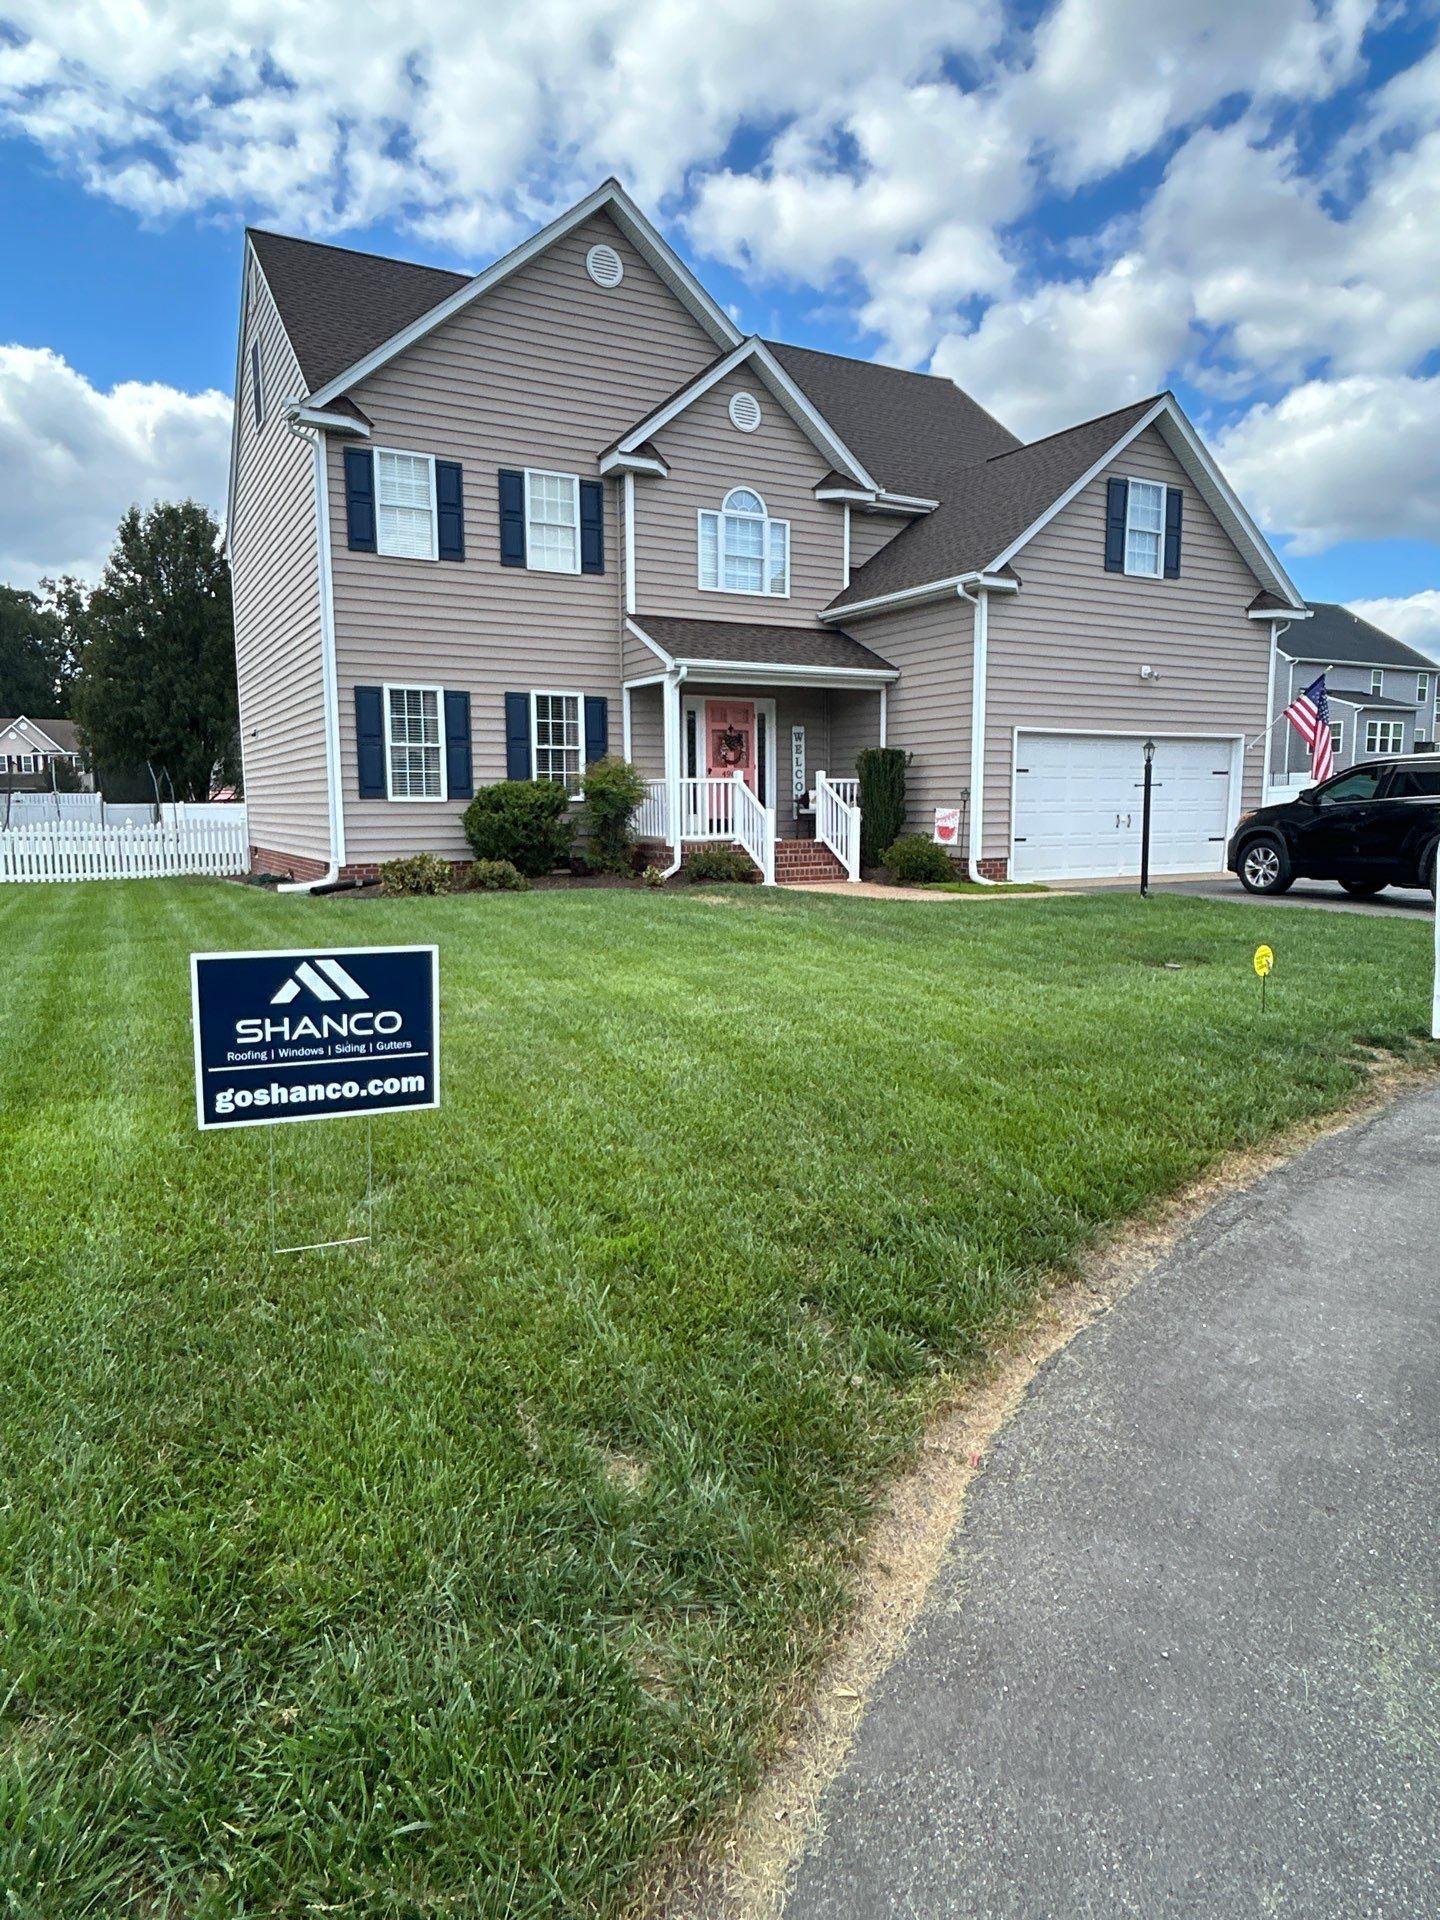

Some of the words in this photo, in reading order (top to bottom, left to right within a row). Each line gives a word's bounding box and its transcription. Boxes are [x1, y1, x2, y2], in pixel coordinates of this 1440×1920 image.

[793, 732, 804, 799] WELCO
[235, 1011, 403, 1044] SHANCO
[227, 1050, 268, 1062] Roofing
[278, 1046, 325, 1058] Windows
[335, 1042, 367, 1054] Siding
[376, 1039, 412, 1051] Gutters
[215, 1075, 425, 1114] goshanco.com
